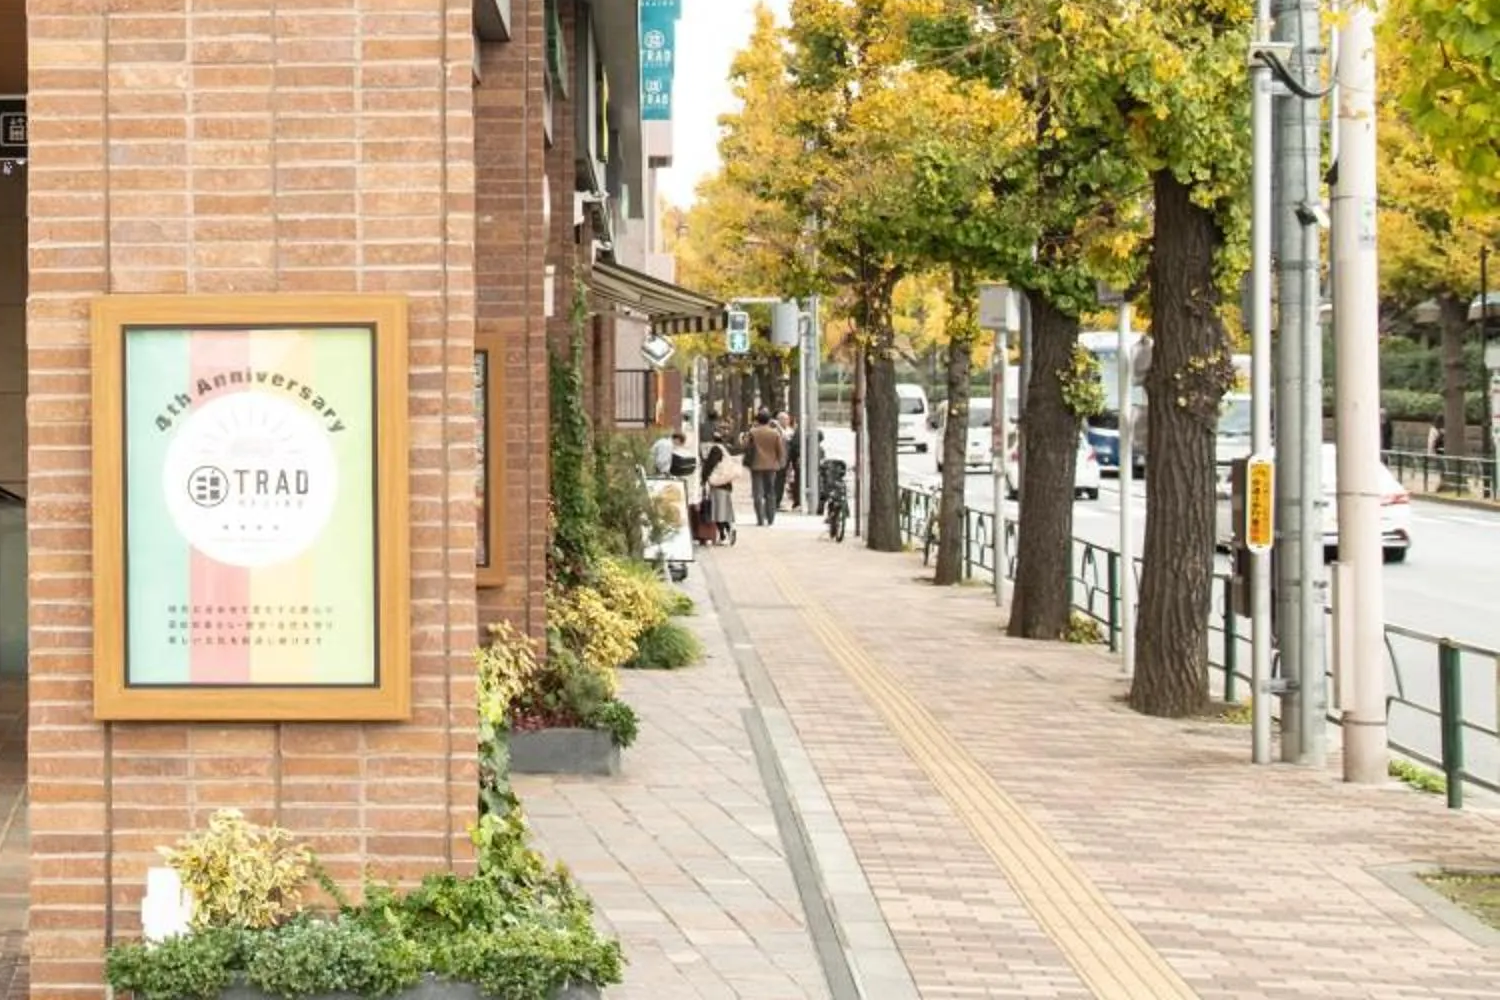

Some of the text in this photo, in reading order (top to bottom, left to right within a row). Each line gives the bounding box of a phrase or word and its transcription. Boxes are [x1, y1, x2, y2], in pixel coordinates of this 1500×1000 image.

[155, 367, 346, 433] 4th Anniversary
[233, 469, 309, 495] TRAD
